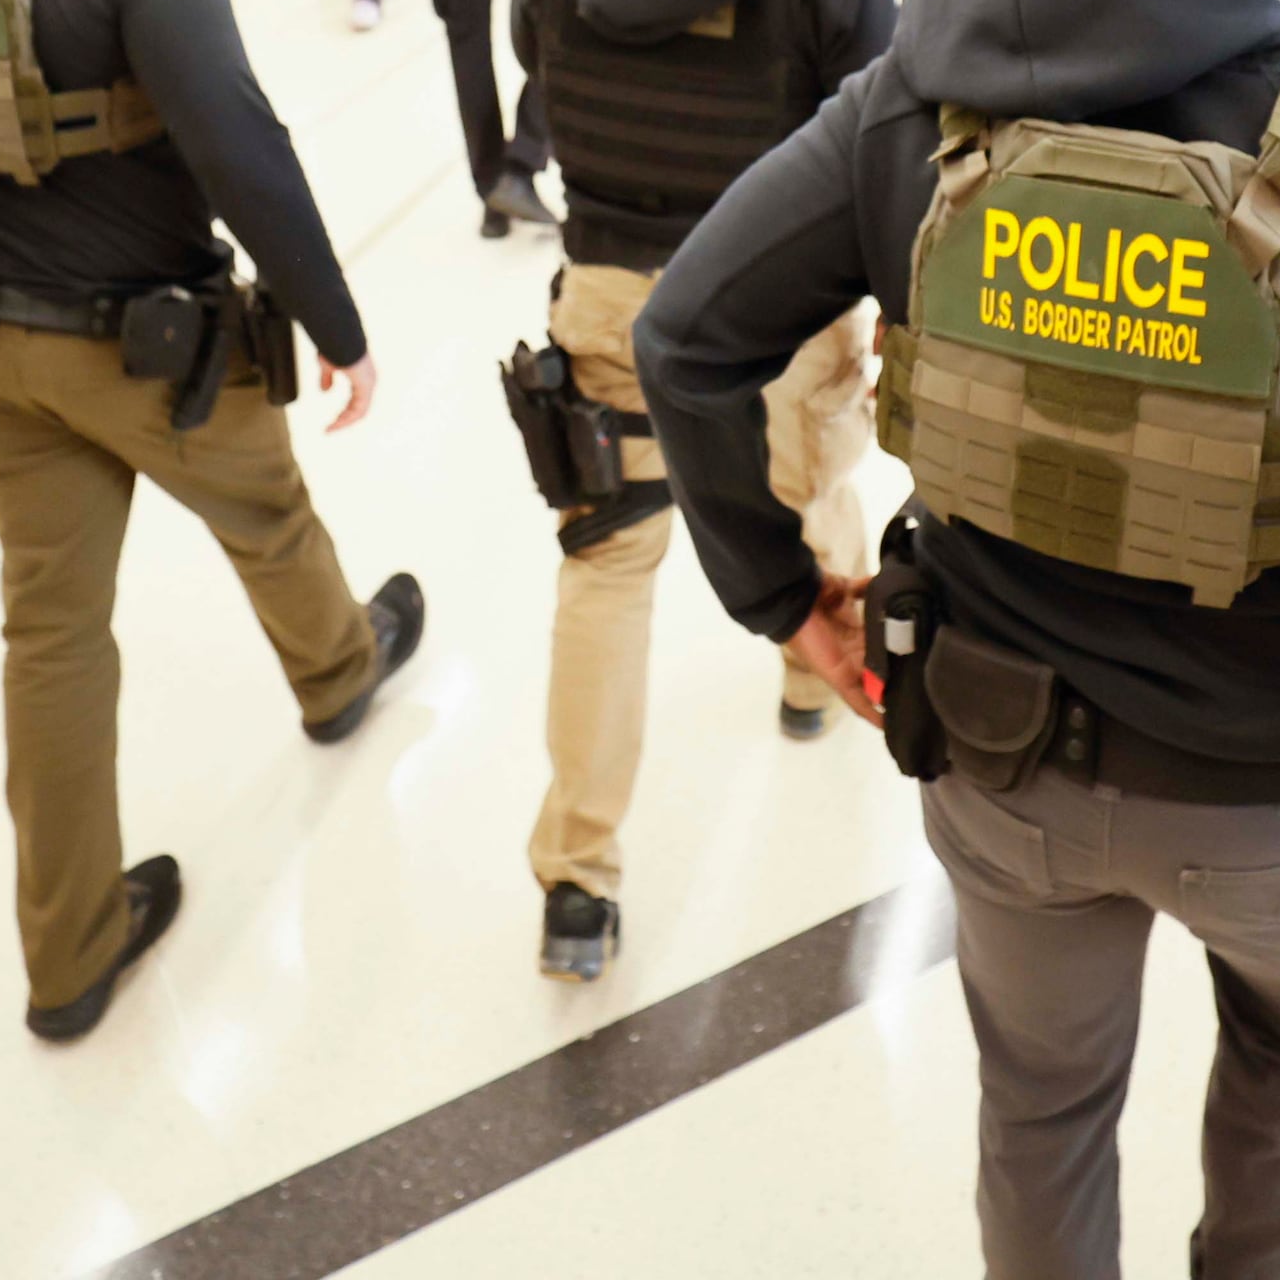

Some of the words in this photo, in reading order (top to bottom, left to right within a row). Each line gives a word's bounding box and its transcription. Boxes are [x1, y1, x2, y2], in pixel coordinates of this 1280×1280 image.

[982, 207, 1210, 318] POLICE
[980, 286, 1016, 332] U.S.
[1022, 297, 1111, 351] BORDER
[1115, 314, 1203, 365] PATROL
